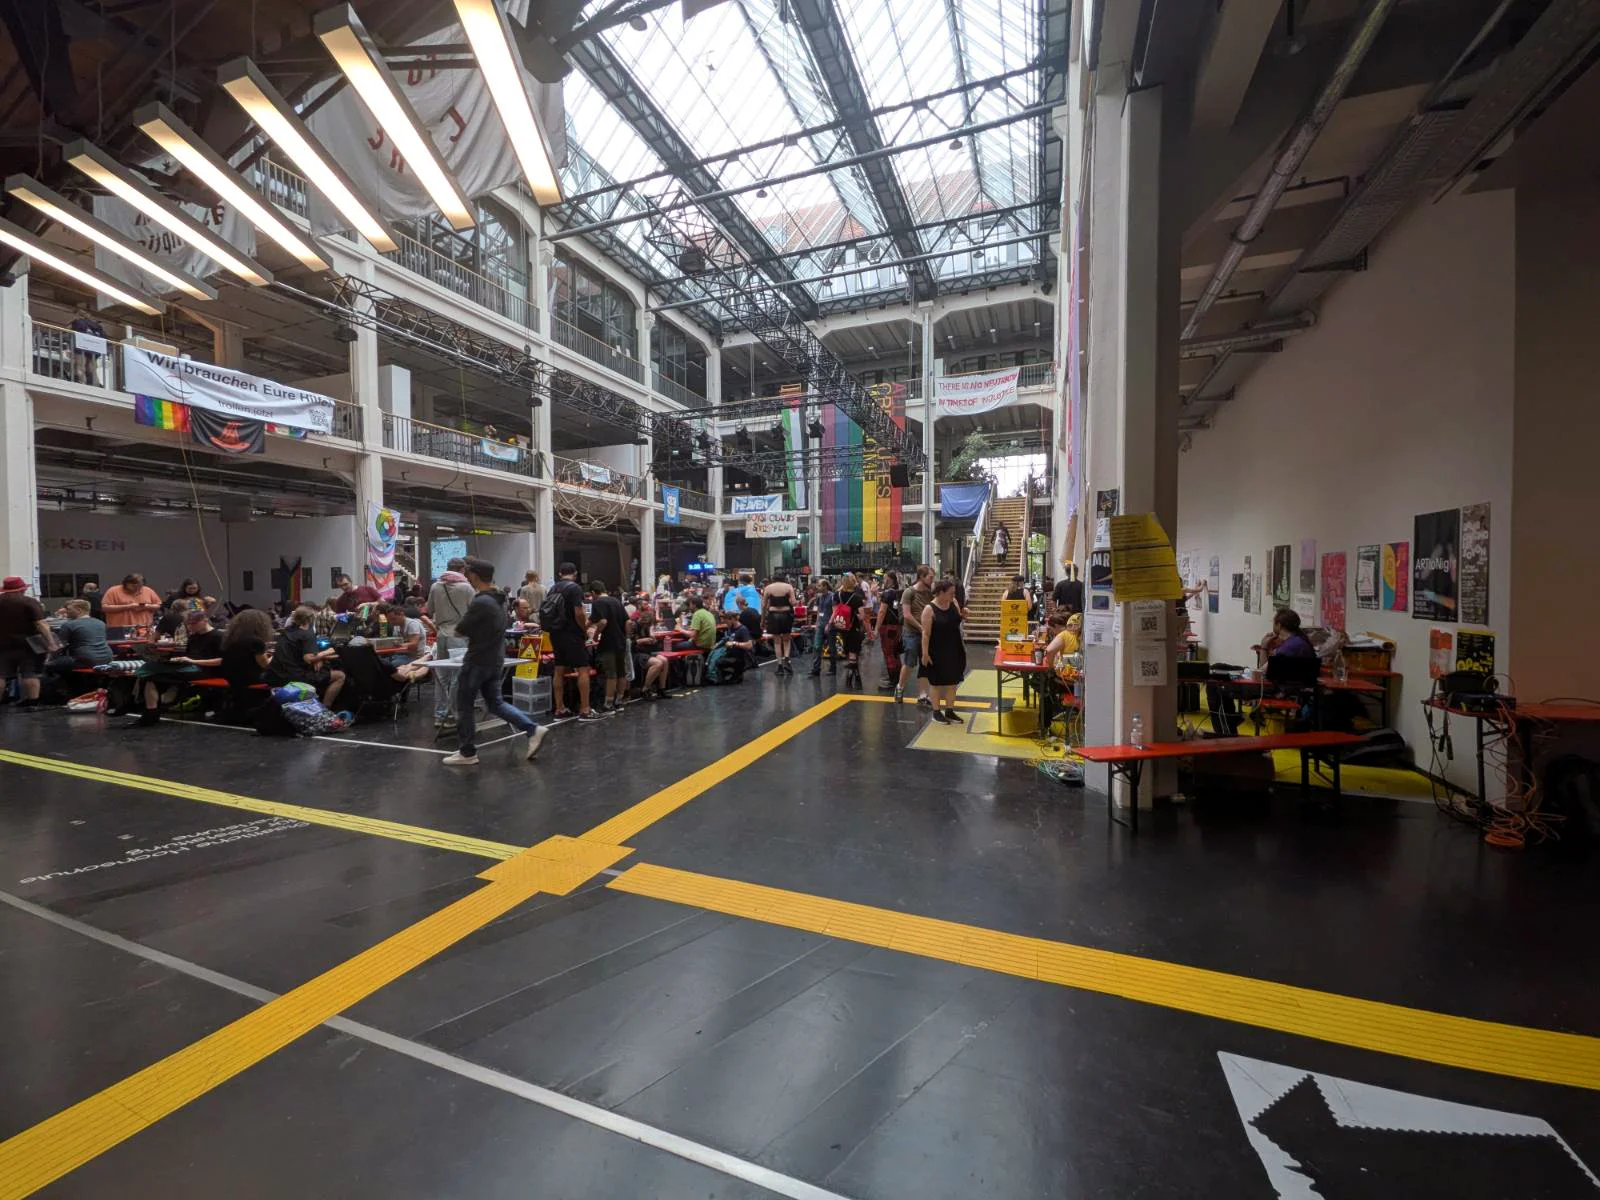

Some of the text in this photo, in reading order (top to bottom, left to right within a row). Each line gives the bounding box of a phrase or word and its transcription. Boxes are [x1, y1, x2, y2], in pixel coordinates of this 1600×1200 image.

[147, 352, 179, 370] Wir
[184, 363, 258, 392] brauchen
[263, 383, 296, 401] Eure
[939, 382, 960, 391] THERE
[970, 381, 982, 390] NO
[968, 397, 978, 406] OF
[19, 846, 190, 884] Hochschule
